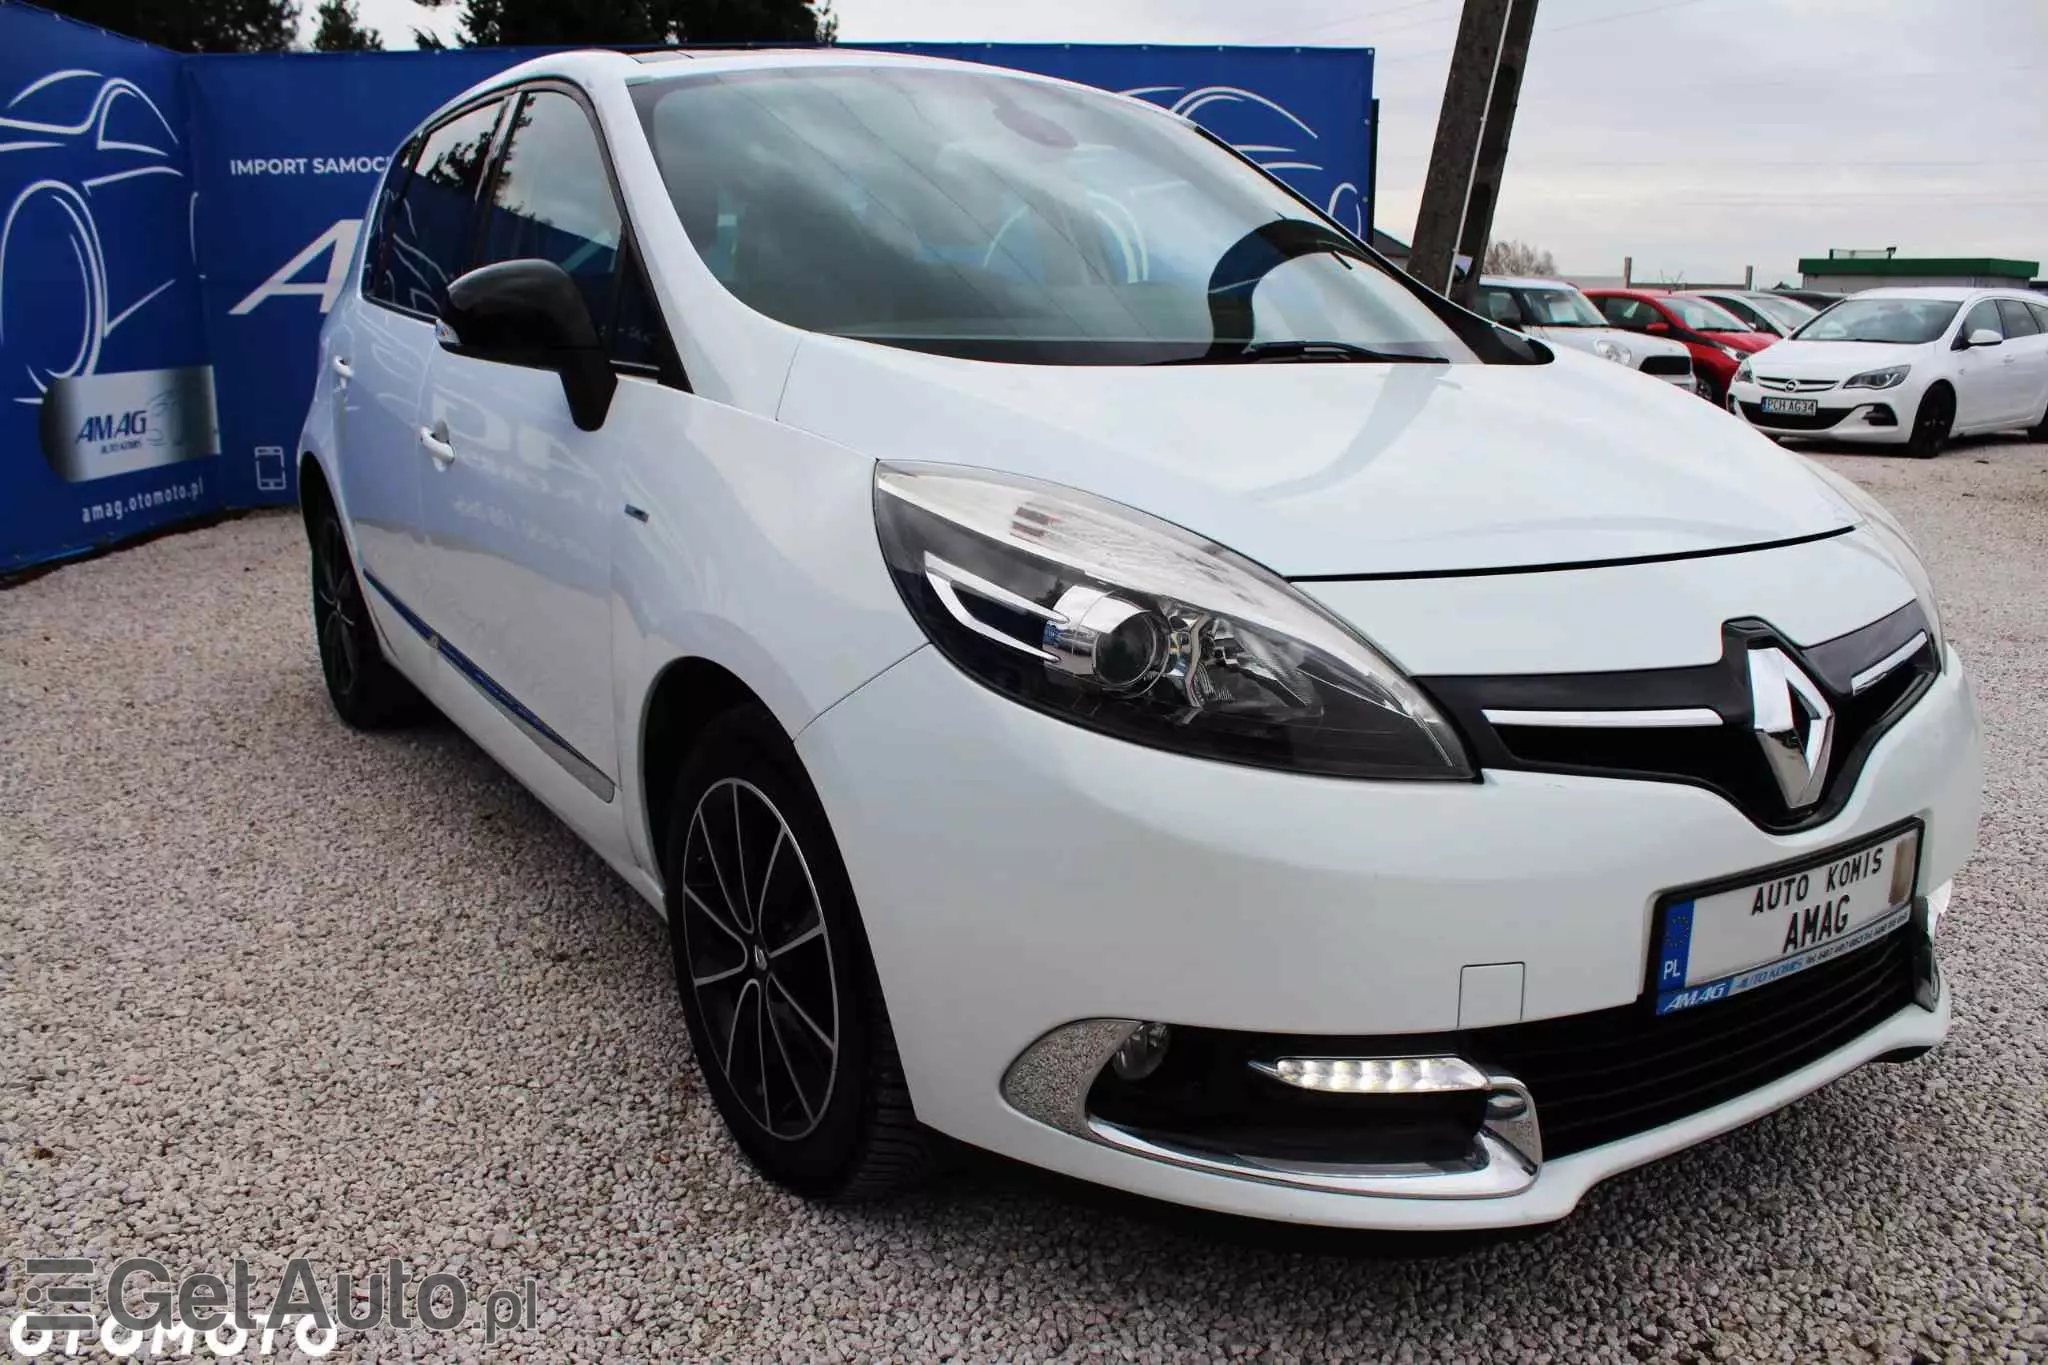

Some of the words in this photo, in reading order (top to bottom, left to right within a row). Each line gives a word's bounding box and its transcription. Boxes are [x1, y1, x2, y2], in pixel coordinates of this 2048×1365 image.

[230, 157, 307, 175] IMPORT
[313, 155, 391, 174] SAMOC
[75, 410, 147, 444] AMAG
[82, 476, 204, 524] amag.otomoto.pl
[1751, 874, 1809, 916] AUTO
[1826, 847, 1884, 892] KOMIS
[1782, 894, 1850, 954] AMAG
[1663, 960, 1681, 980] PL
[1663, 982, 1727, 1012] AMAG
